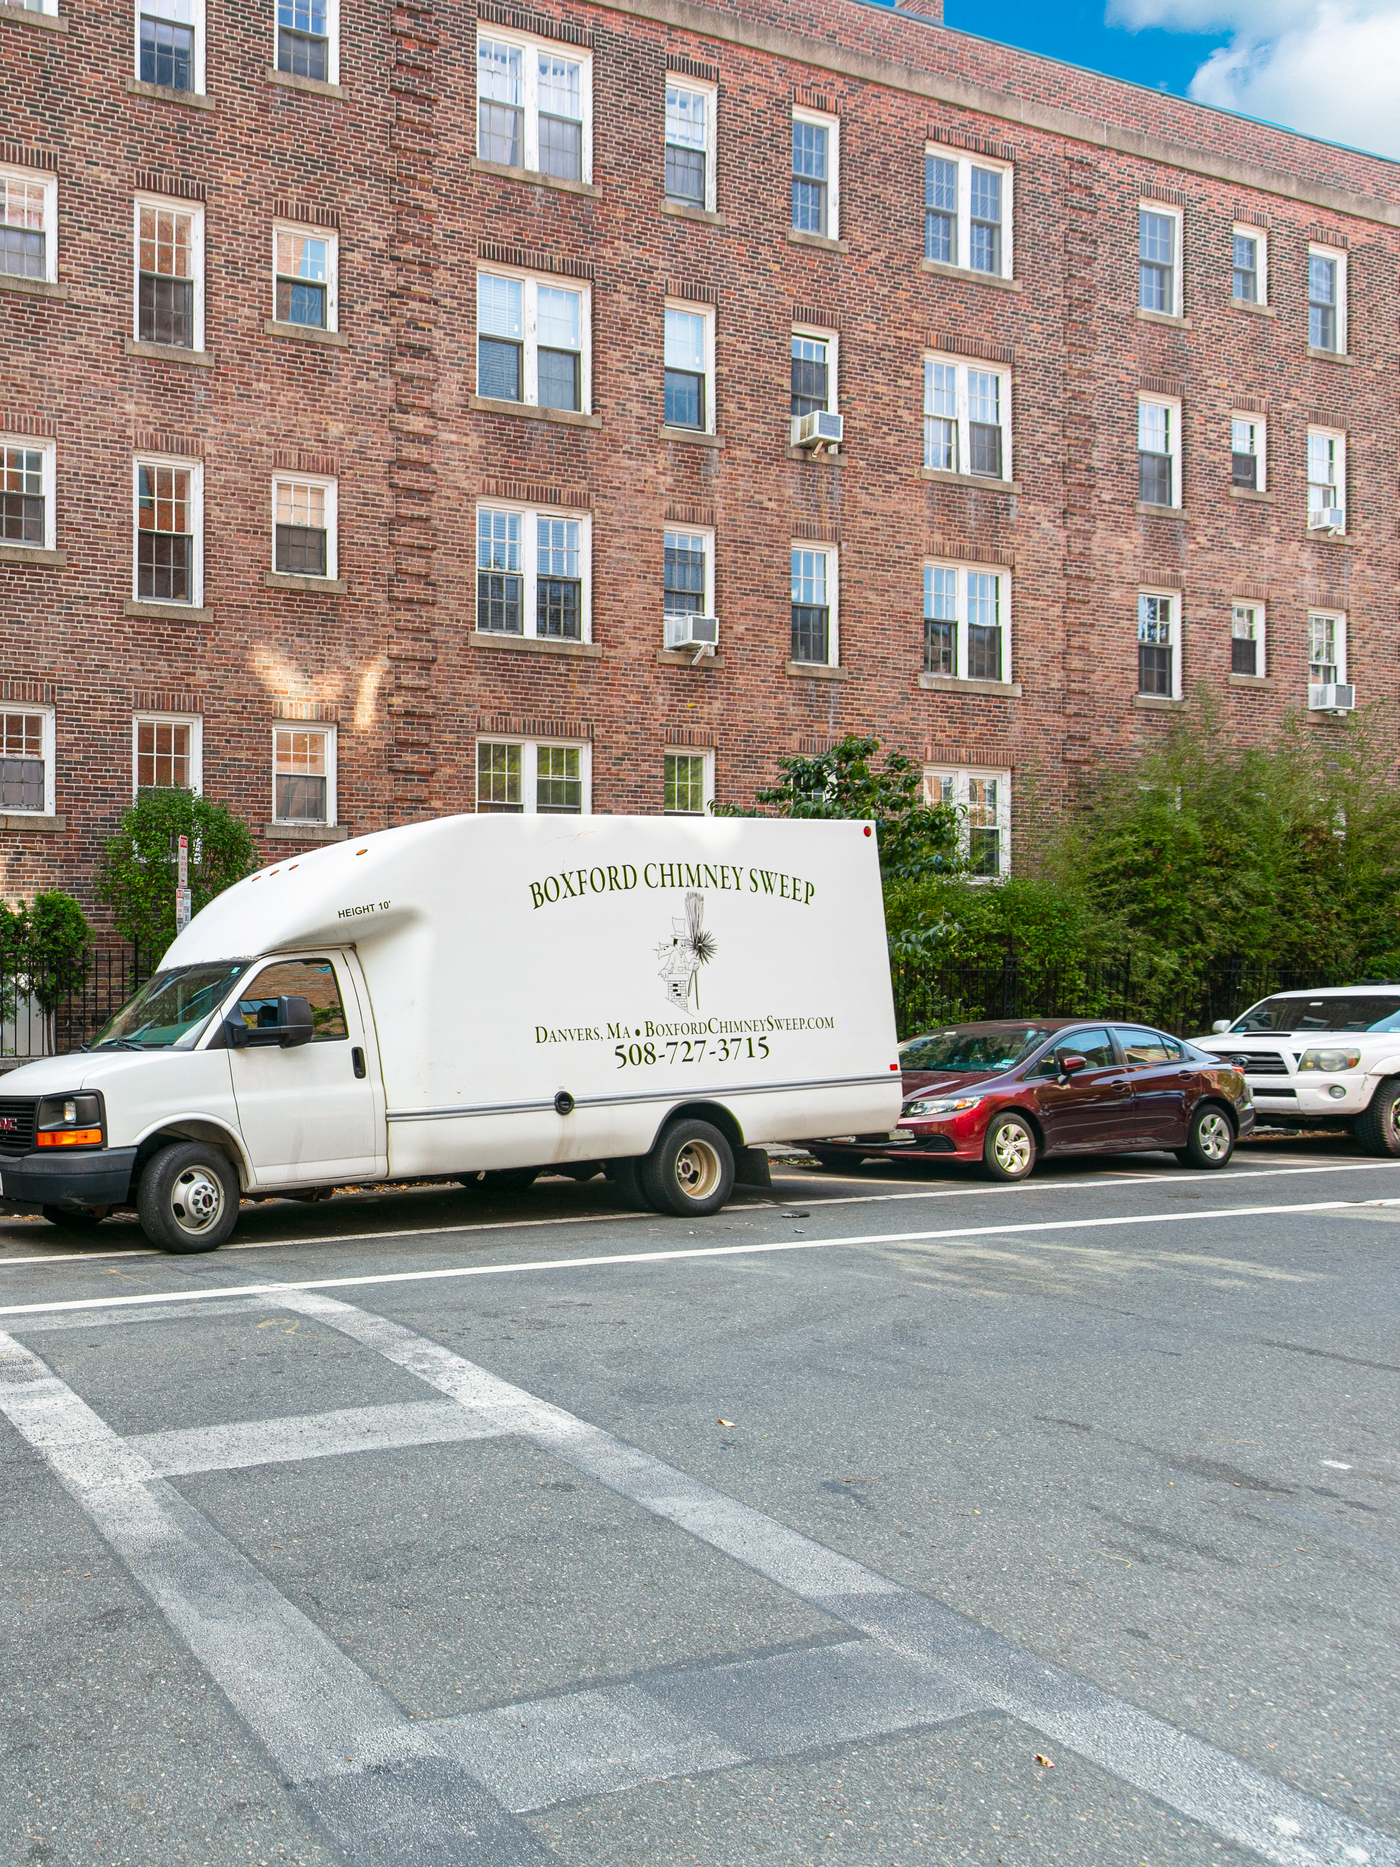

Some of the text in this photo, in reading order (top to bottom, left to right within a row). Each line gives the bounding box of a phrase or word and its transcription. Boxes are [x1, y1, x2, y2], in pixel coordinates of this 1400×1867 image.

[528, 862, 815, 910] BOXFORD CHIMNEY SWEEP
[337, 900, 391, 919] HEIGHT 10'
[614, 1035, 770, 1069] 508-727-3715
